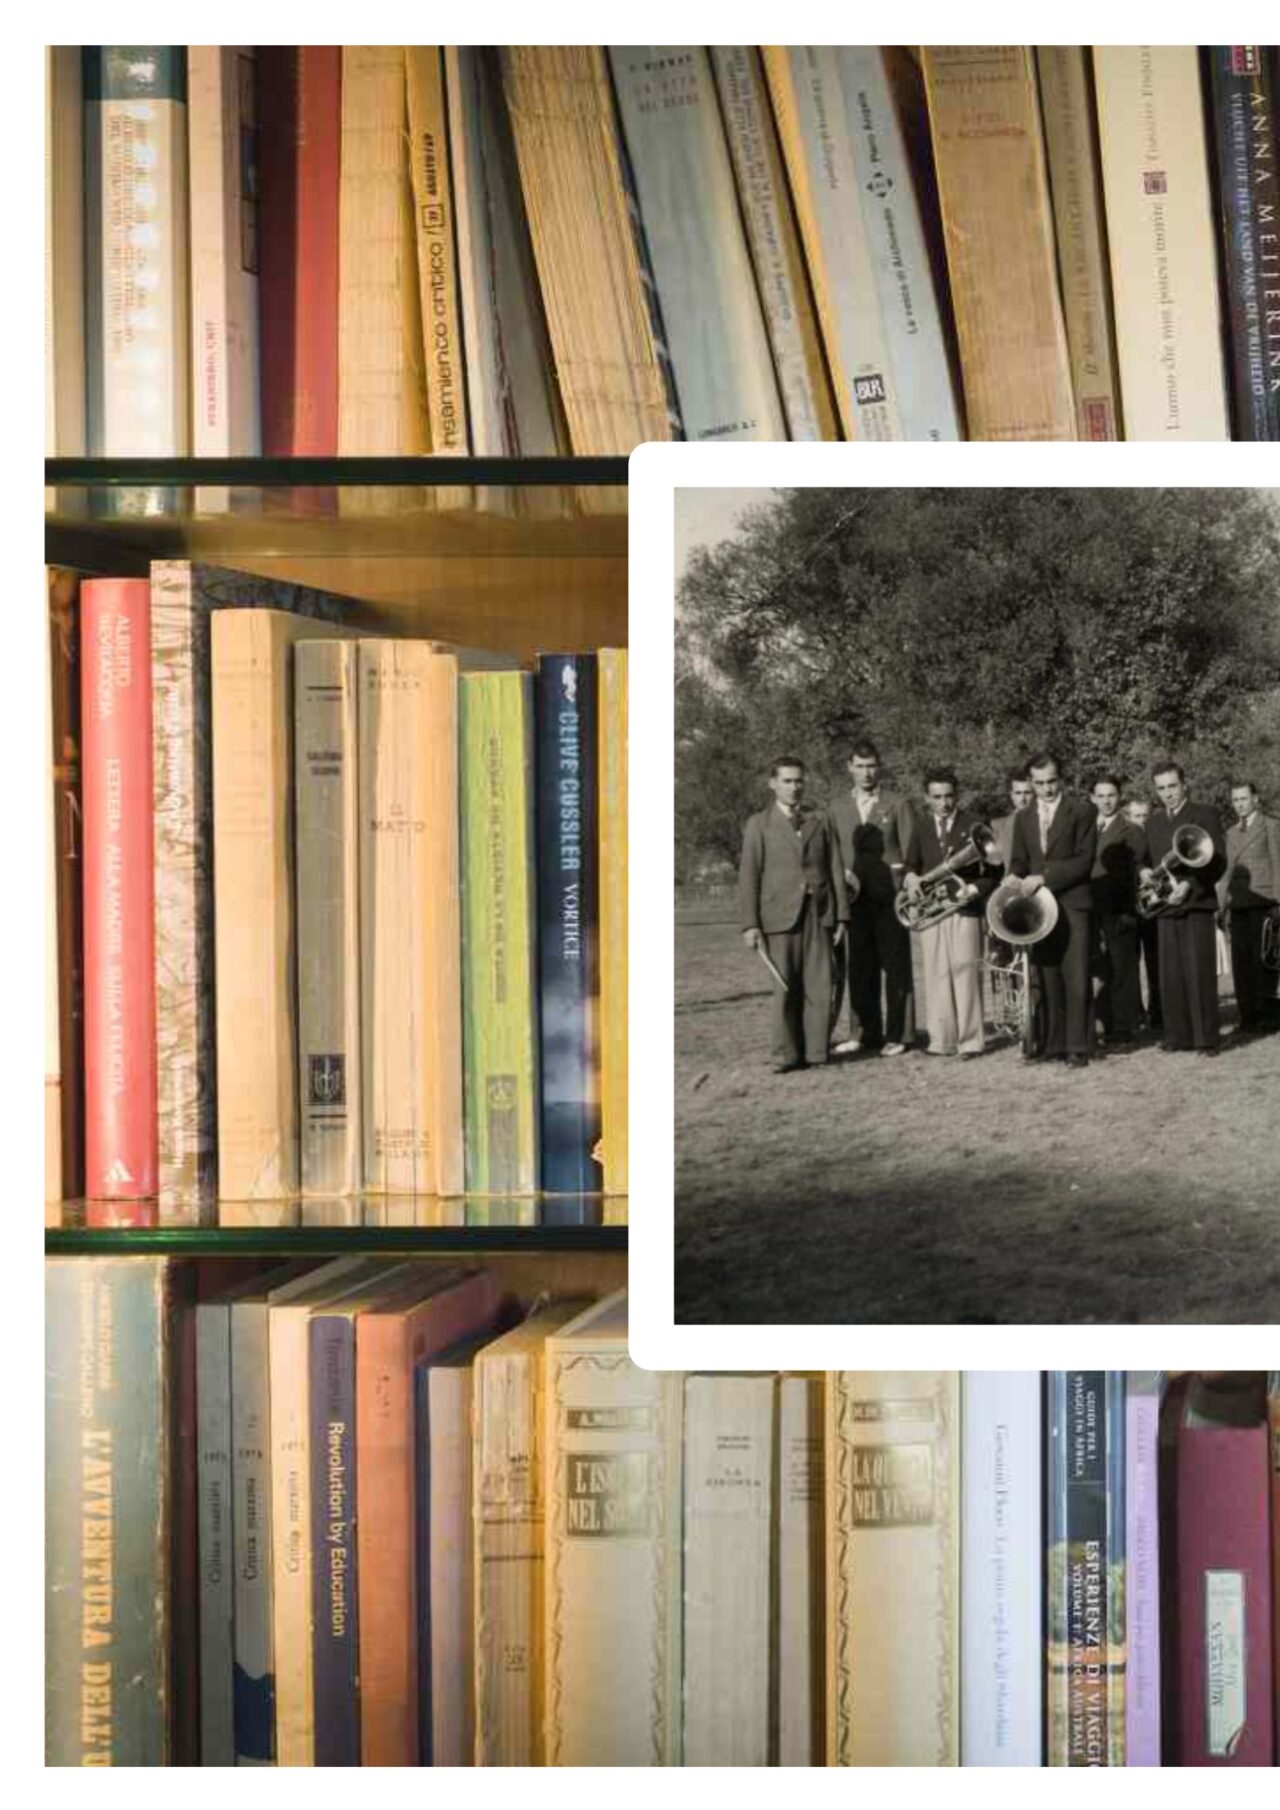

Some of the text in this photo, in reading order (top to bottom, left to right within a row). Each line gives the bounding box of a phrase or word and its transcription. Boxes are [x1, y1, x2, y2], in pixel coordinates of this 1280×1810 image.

[1250, 92, 1274, 184] ANNA
[116, 615, 131, 688] ALBERTO
[106, 758, 122, 832] LETTERA
[558, 712, 580, 871] CLIVE CUSSLER
[563, 884, 580, 960] VORTICE
[328, 1421, 345, 1518] Revolution
[83, 1428, 113, 1649] L'AVVENTURA
[327, 1522, 346, 1543] by
[331, 1547, 347, 1637] Education
[1085, 1540, 1102, 1767] ESPERIENZE DI VIAGGI
